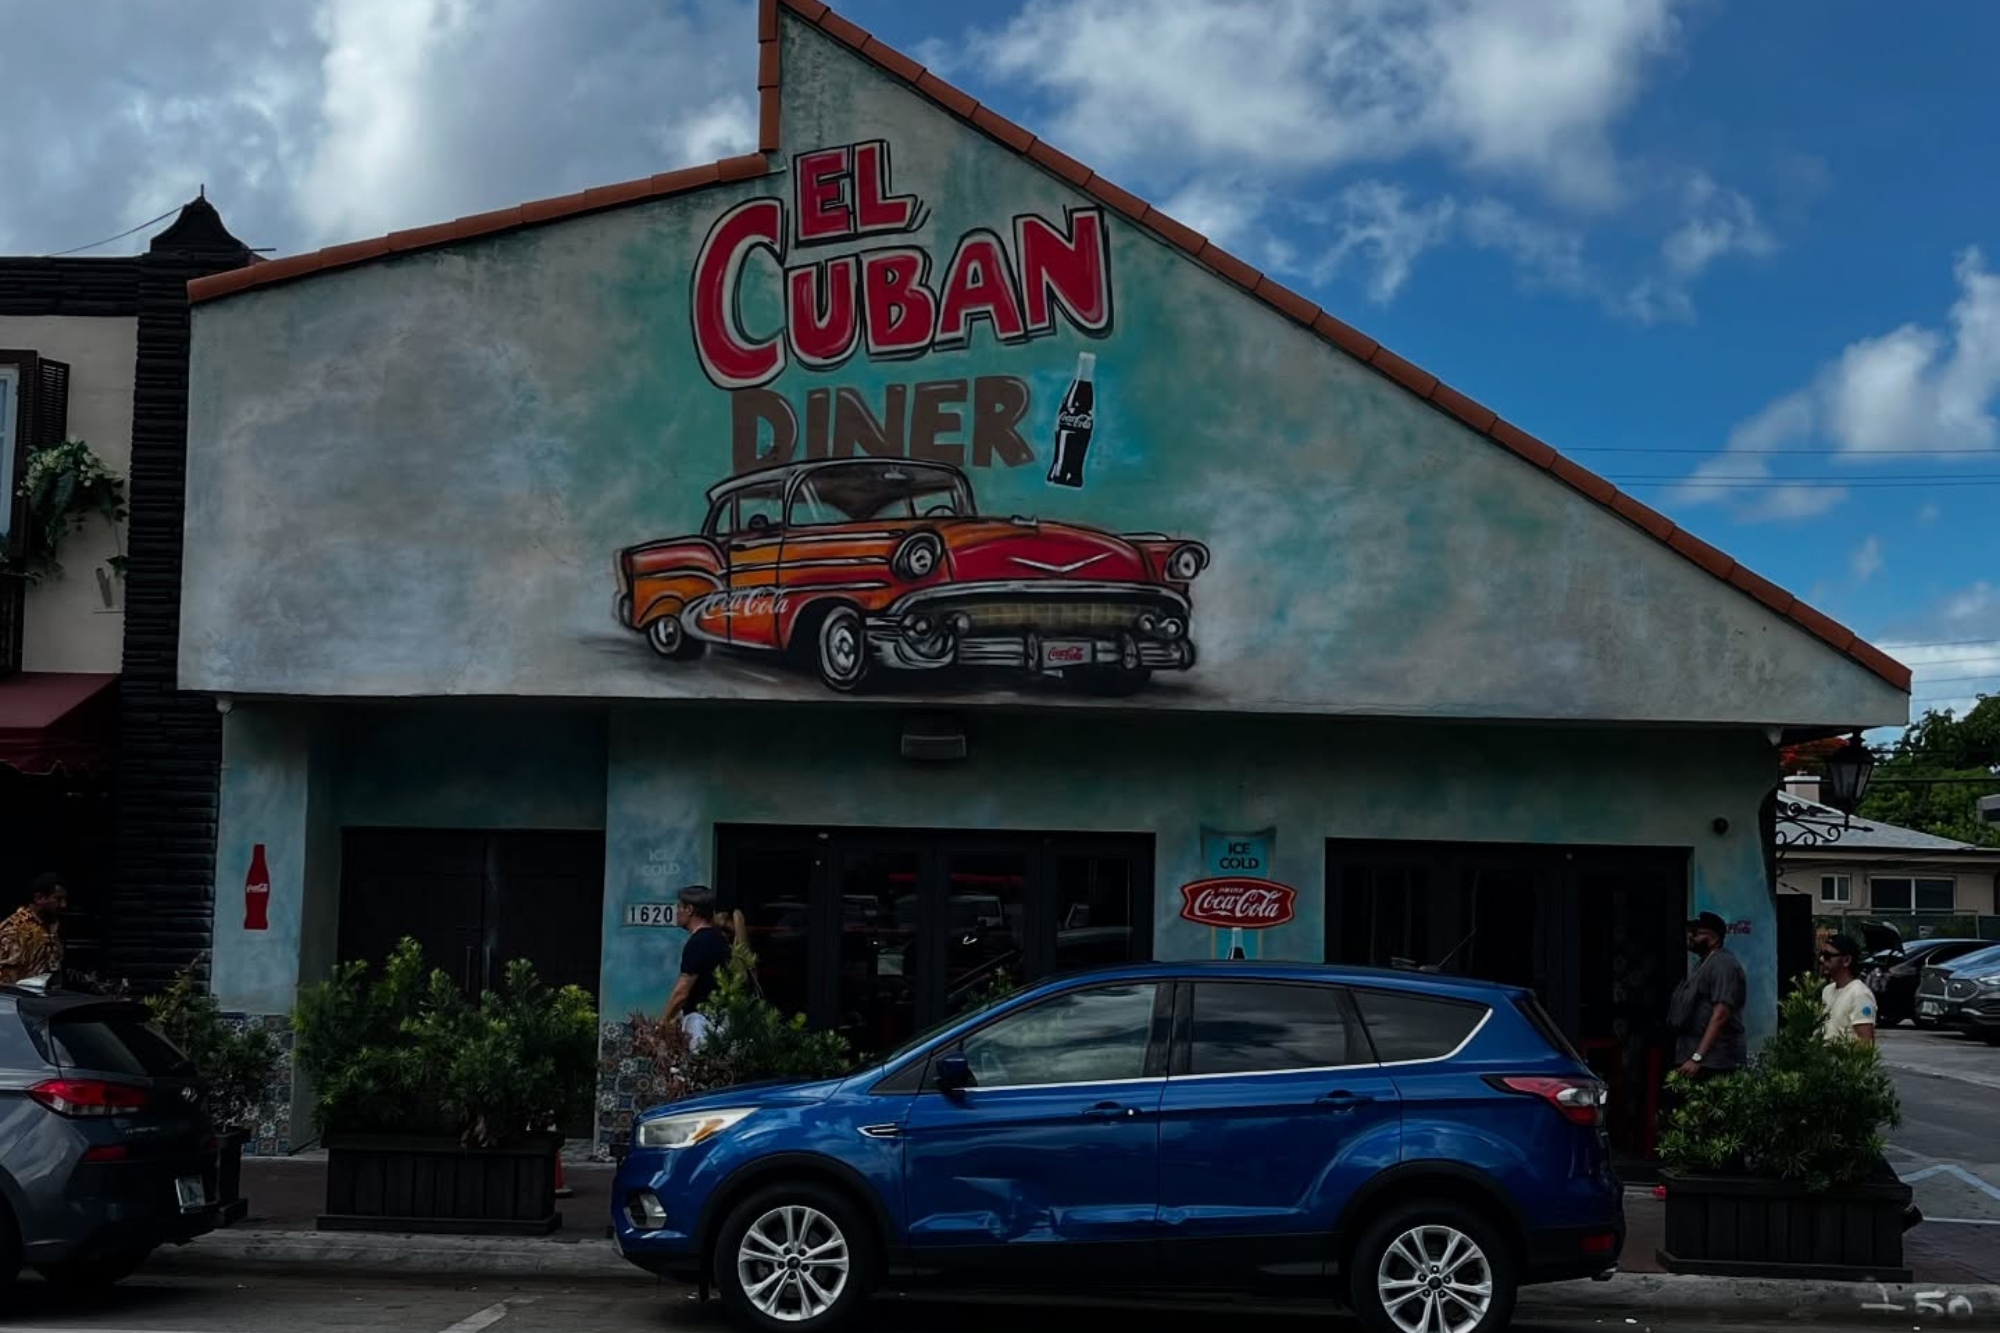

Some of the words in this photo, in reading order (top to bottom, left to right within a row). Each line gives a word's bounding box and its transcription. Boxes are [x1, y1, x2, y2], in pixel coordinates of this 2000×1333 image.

[793, 139, 926, 248] EL
[690, 198, 1114, 389] CUBAN
[731, 376, 1035, 475] DINER
[1219, 857, 1259, 870] COLD
[1228, 842, 1251, 855] ICE
[630, 905, 674, 924] 1620
